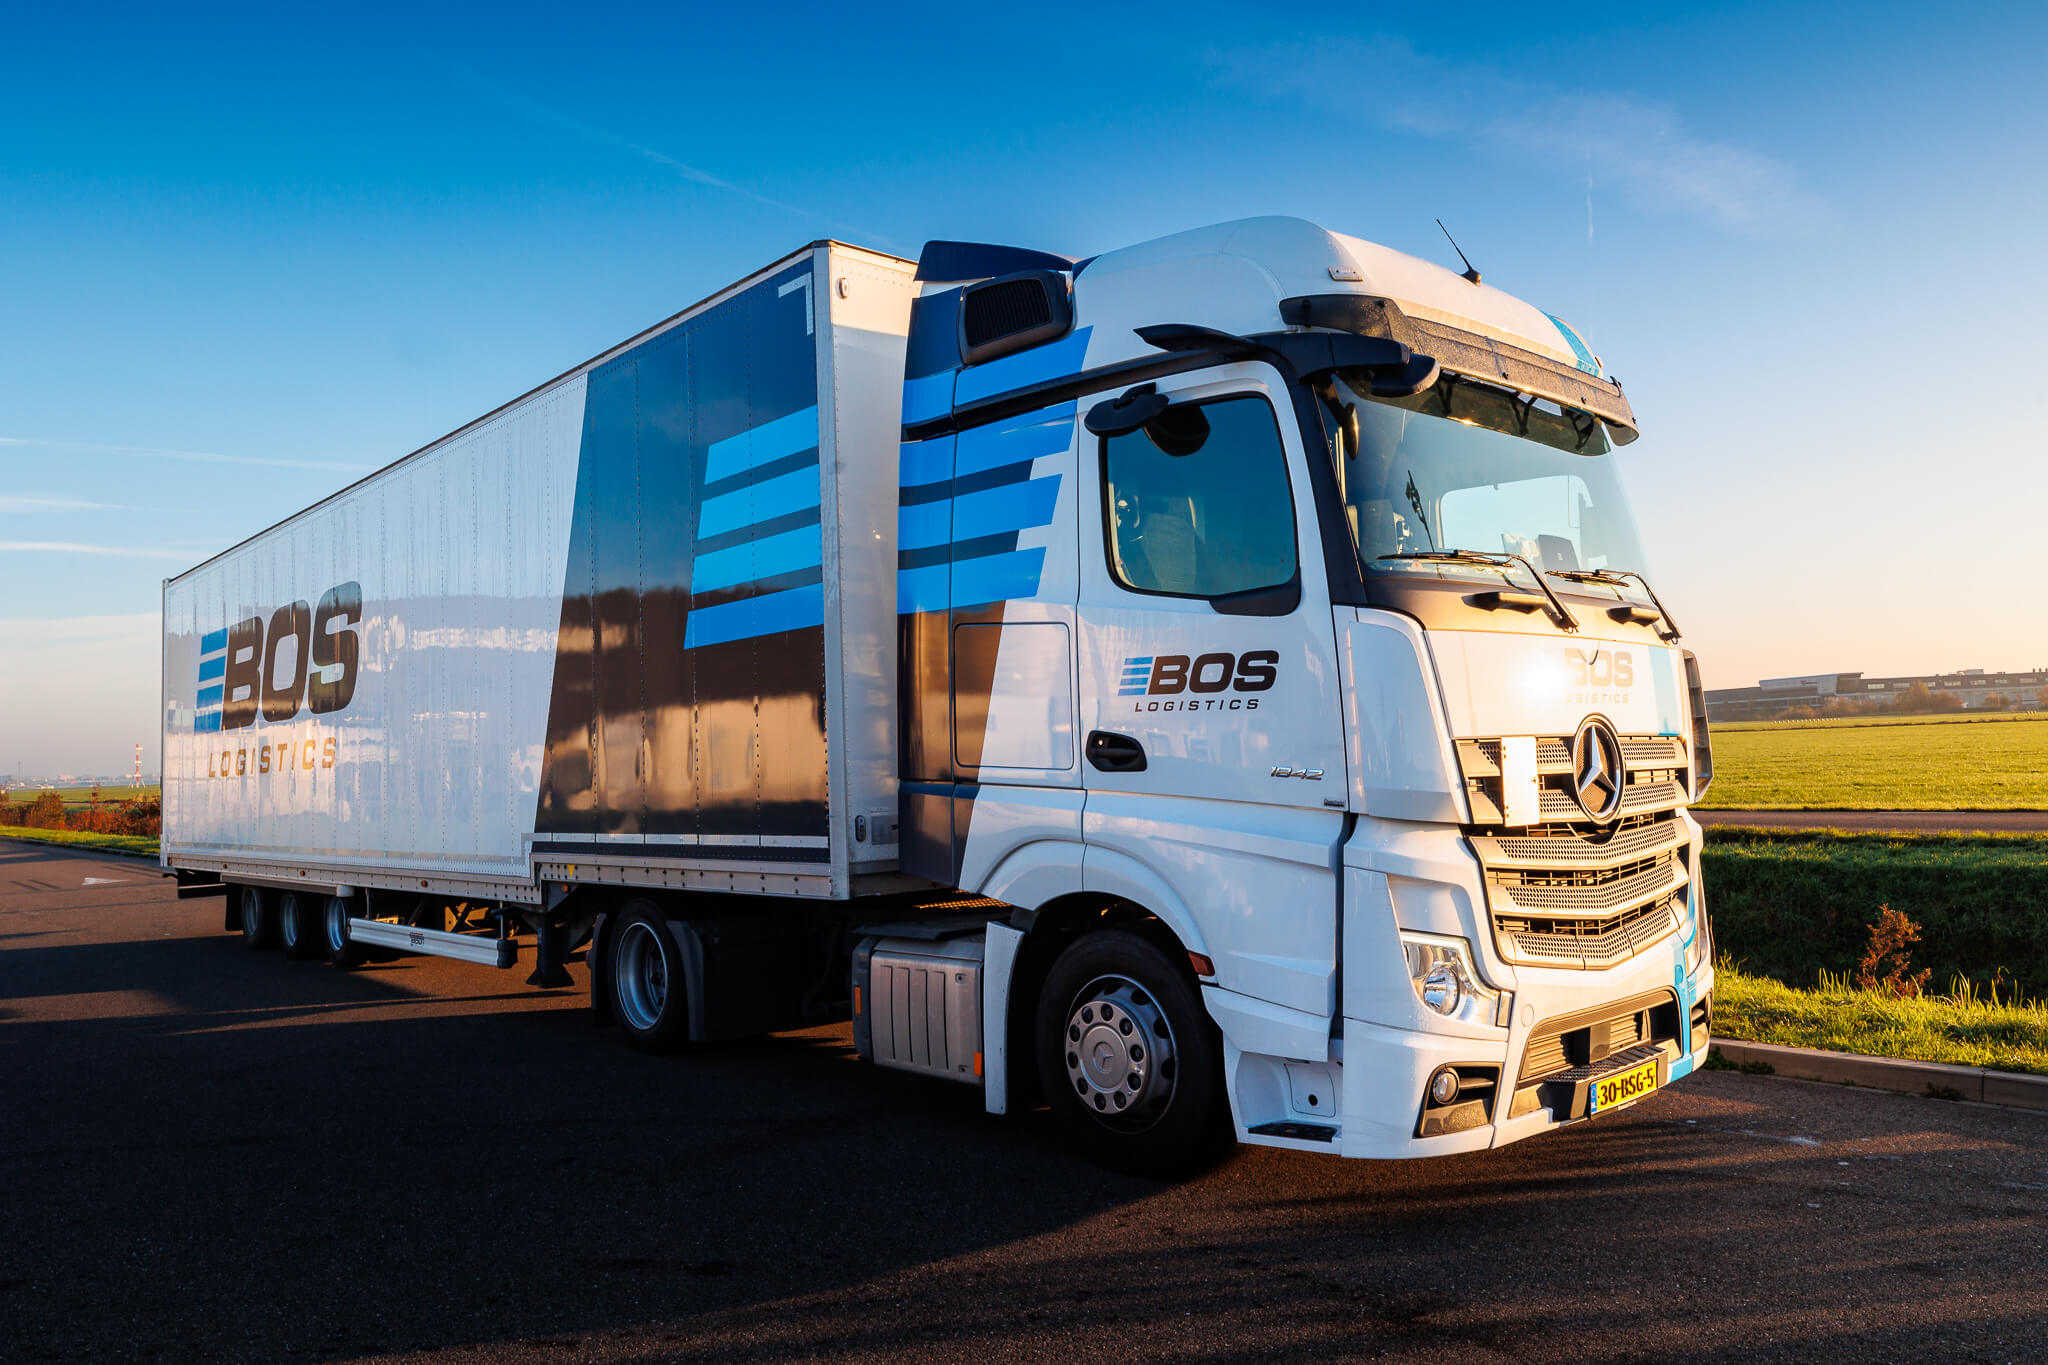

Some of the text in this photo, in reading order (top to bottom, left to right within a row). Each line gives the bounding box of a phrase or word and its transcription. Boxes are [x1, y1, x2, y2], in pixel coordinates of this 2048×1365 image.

[221, 580, 362, 731] BOS
[1148, 650, 1279, 695] BOS
[1135, 699, 1259, 712] LOGISTICS
[208, 737, 336, 777] LOGISTICS
[1271, 766, 1324, 780] 1842
[1600, 1067, 1654, 1106] 30-BSG-5
